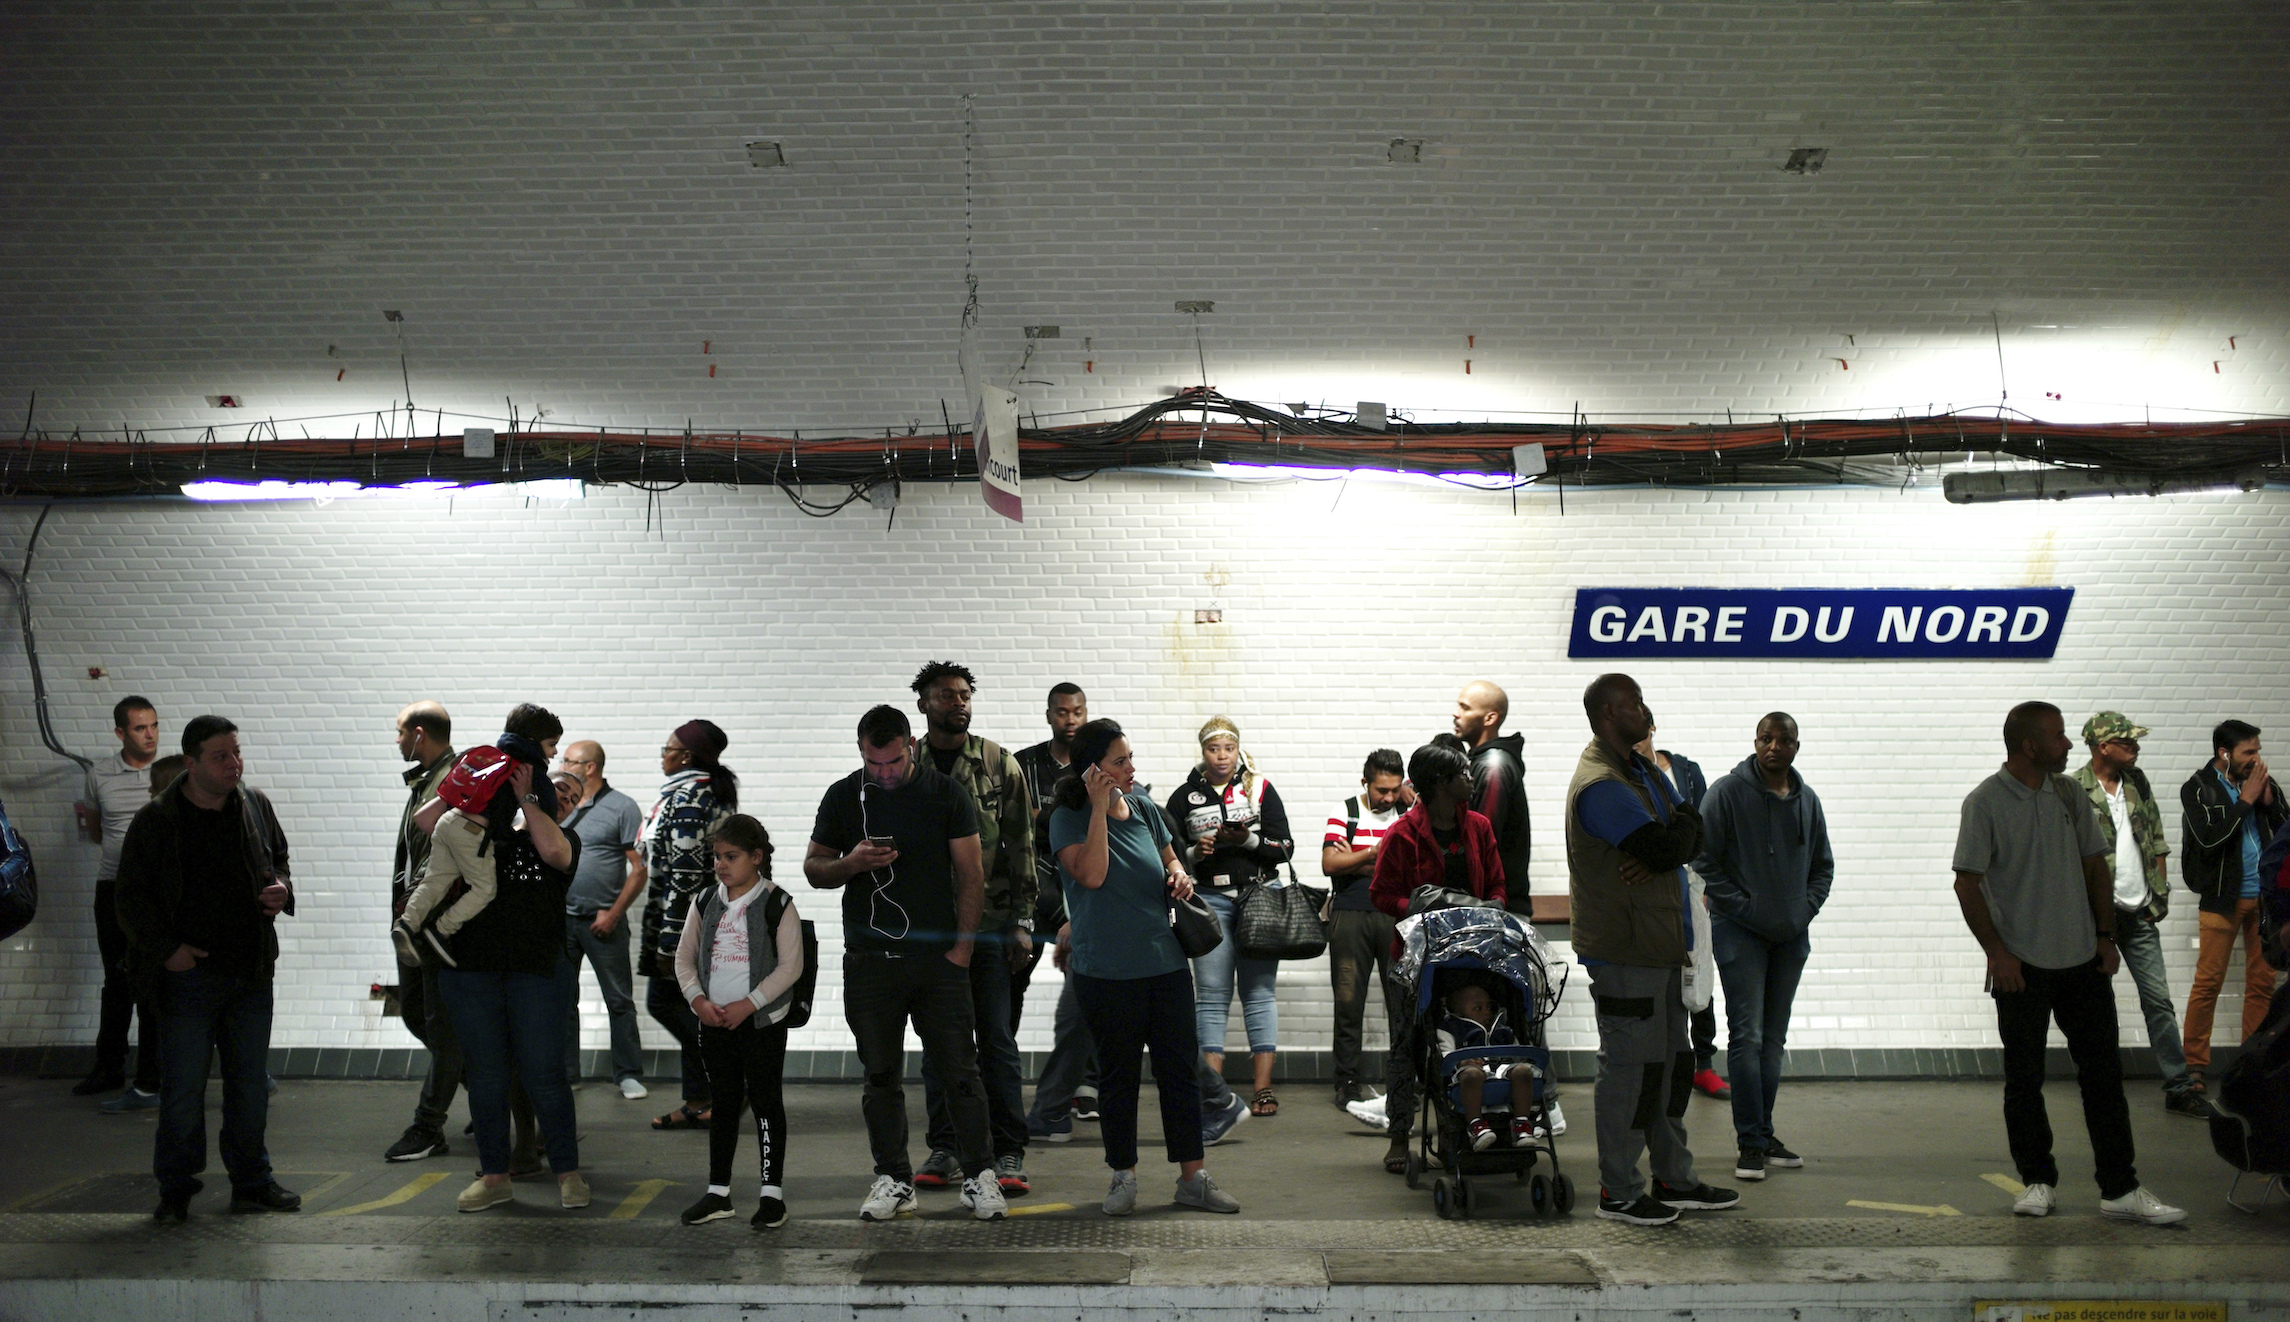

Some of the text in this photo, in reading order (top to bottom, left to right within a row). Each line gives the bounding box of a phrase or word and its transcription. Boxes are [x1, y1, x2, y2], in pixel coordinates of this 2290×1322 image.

[1588, 605, 2051, 643] GARE DU NORD
[2054, 1311, 2077, 1322] pas
[2080, 1308, 2147, 1320] descendre
[2150, 1311, 2171, 1320] sur
[2174, 1308, 2186, 1320] la
[2190, 1308, 2217, 1320] voie
